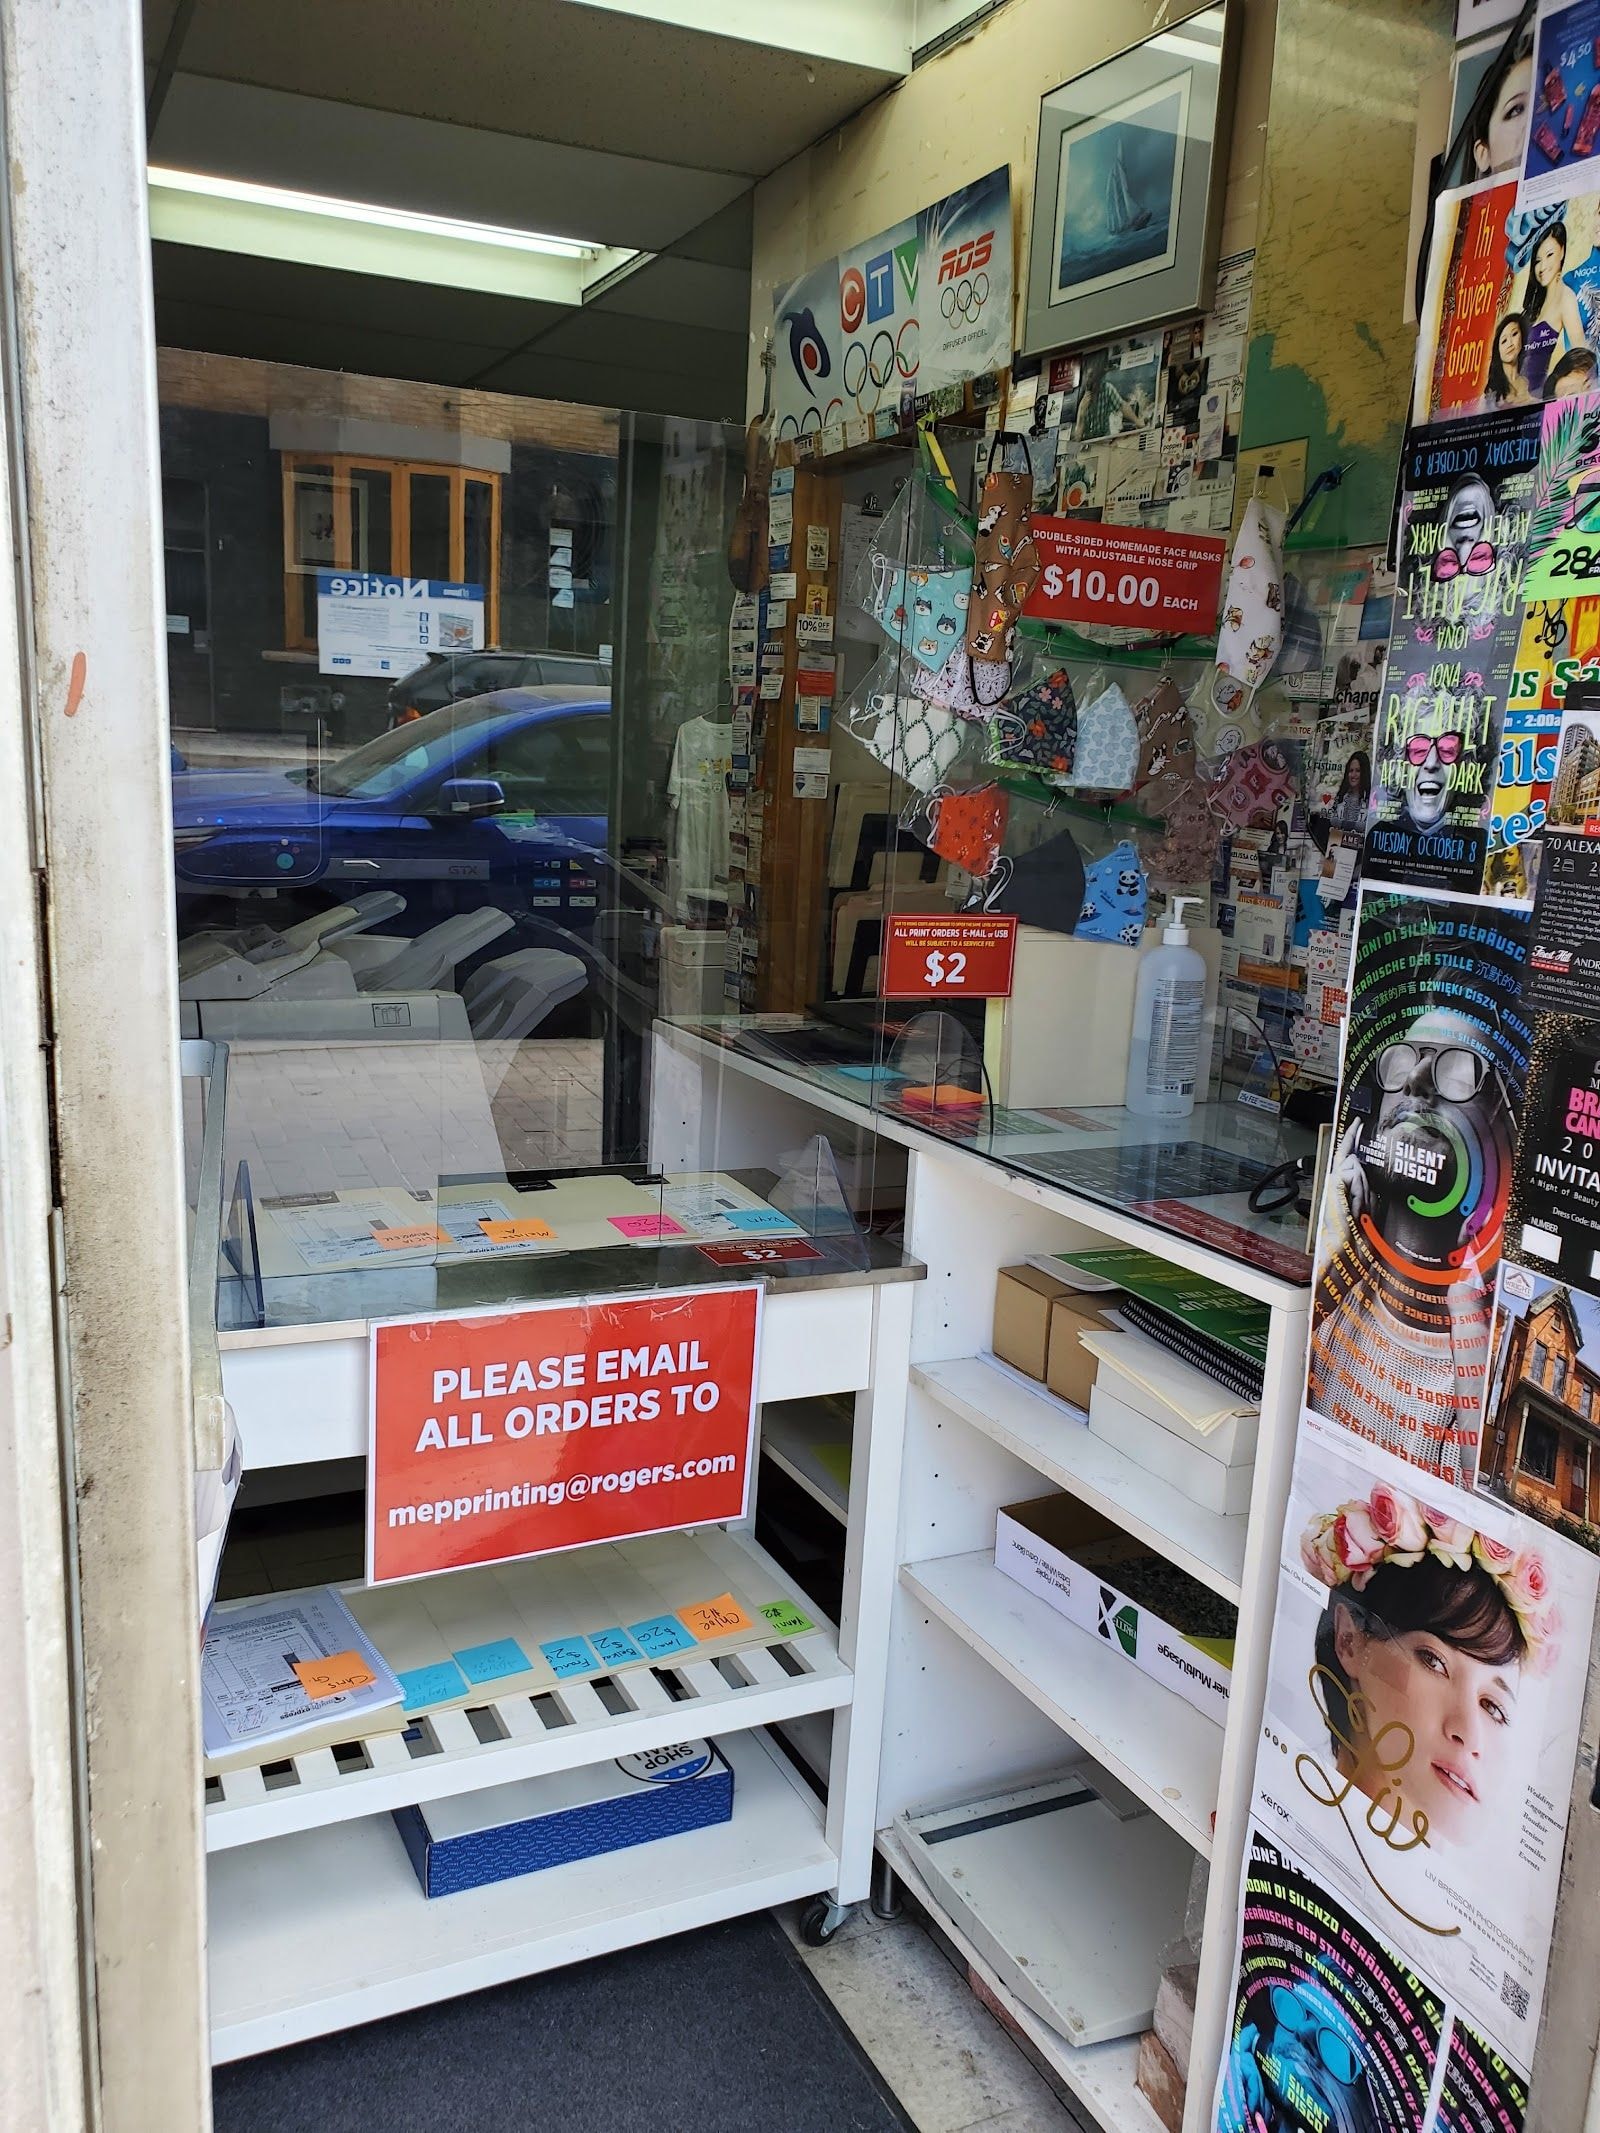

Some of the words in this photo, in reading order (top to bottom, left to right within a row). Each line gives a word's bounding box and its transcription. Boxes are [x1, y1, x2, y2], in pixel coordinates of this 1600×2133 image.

[841, 250, 919, 325] CTV
[1427, 448, 1478, 475] OCTOBER
[1033, 529, 1103, 547] DOUBLE-SIDED
[1106, 539, 1160, 555] HOMEMADE
[1163, 546, 1187, 558] FACE
[1189, 550, 1222, 563] MASKS
[1055, 544, 1080, 556] WITH
[1083, 549, 1145, 564] ADJUSTABLE
[1147, 556, 1174, 568] NOSE
[1176, 560, 1198, 571] GRIP
[1042, 563, 1160, 608] $10.00
[1163, 596, 1199, 610] EACH
[798, 619, 817, 632] 10%
[1436, 622, 1469, 650] IONA
[1429, 661, 1461, 690] IONA
[1307, 759, 1343, 773] Cristina
[1447, 761, 1487, 795] DARK
[1418, 836, 1465, 861] OCTOBER
[1469, 841, 1477, 863] 8
[1546, 838, 1562, 850] 70
[1553, 857, 1560, 868] 2
[894, 929, 907, 937] ALL
[909, 929, 931, 937] PRINT
[931, 929, 959, 938] ORDERS
[962, 930, 986, 938] E-MAIL
[994, 930, 1009, 938] USB
[1384, 930, 1397, 945] DI
[1400, 921, 1454, 940] SILENZO
[1310, 945, 1335, 956] poppies
[924, 950, 967, 987] $2
[1352, 957, 1406, 1002] GERÄUSCHE
[1409, 953, 1431, 967] DER
[1435, 953, 1474, 972] STILLE
[1465, 988, 1497, 1010] CISZY
[1453, 1009, 1492, 1035] SILENCE
[1295, 1031, 1320, 1042] poppies
[1457, 1034, 1495, 1061] SILENCIO
[1359, 1144, 1386, 1161] STUDENT
[1366, 1155, 1385, 1168] UNION
[1395, 1141, 1446, 1170] SILENT
[1394, 1159, 1437, 1186] DISCO
[1538, 1179, 1558, 1194] Night
[1561, 1187, 1571, 1196] of
[1574, 1191, 1600, 1207] Beauty
[1531, 1216, 1558, 1233] NUMBER
[1553, 1207, 1570, 1220] Dress
[1570, 1211, 1590, 1226] Code:
[1404, 1306, 1443, 1324] SILENCE
[432, 1354, 587, 1404] PLEASE
[596, 1340, 709, 1384] EMAIL
[415, 1412, 494, 1453] ALL
[504, 1390, 660, 1440] ORDERS
[671, 1381, 720, 1416] TO
[388, 1453, 736, 1528] mepprinting@rogers.com
[1035, 1568, 1051, 1585] Papier
[1041, 1559, 1059, 1578] White
[1059, 1571, 1071, 1587] Extra
[1055, 1580, 1071, 1597] Paper
[699, 1612, 741, 1631] Chloe
[1157, 1643, 1212, 1688] MultiUsage
[328, 1675, 369, 1689] Chris
[644, 1745, 694, 1770] SHOP
[1260, 1790, 1291, 1823] xerox
[1527, 1785, 1555, 1811] Wedding
[1523, 1812, 1548, 1834] Boudoir
[1525, 1799, 1565, 1832] Engagement
[1521, 1825, 1544, 1846] Seniors
[1518, 1851, 1540, 1872] Events
[1520, 1838, 1547, 1863] Families
[1425, 1869, 1437, 1882] LIV
[1438, 1879, 1475, 1914] BRESSON
[1476, 1911, 1535, 1965] PHOTOGRAPHY
[1244, 1904, 1294, 1929] GERÄUSCHE
[1296, 1921, 1318, 1945] DER
[1319, 1941, 1355, 1978] STILLE
[1274, 1887, 1287, 1898] DI
[1288, 1889, 1340, 1935] SILENZO
[1341, 1929, 1414, 2027] GERÄUSCHE
[1411, 2025, 1436, 2065] DER
[1406, 1975, 1424, 1998] DI
[1345, 1986, 1373, 2027] CISZY
[1373, 2031, 1406, 2095] SOUNDS
[1492, 2055, 1509, 2081] DI
[1365, 2042, 1396, 2098] SONIDOS
[1394, 2099, 1406, 2122] DEL
[1287, 2087, 1323, 2133] DISCO
[1288, 2074, 1330, 2128] SILENT
